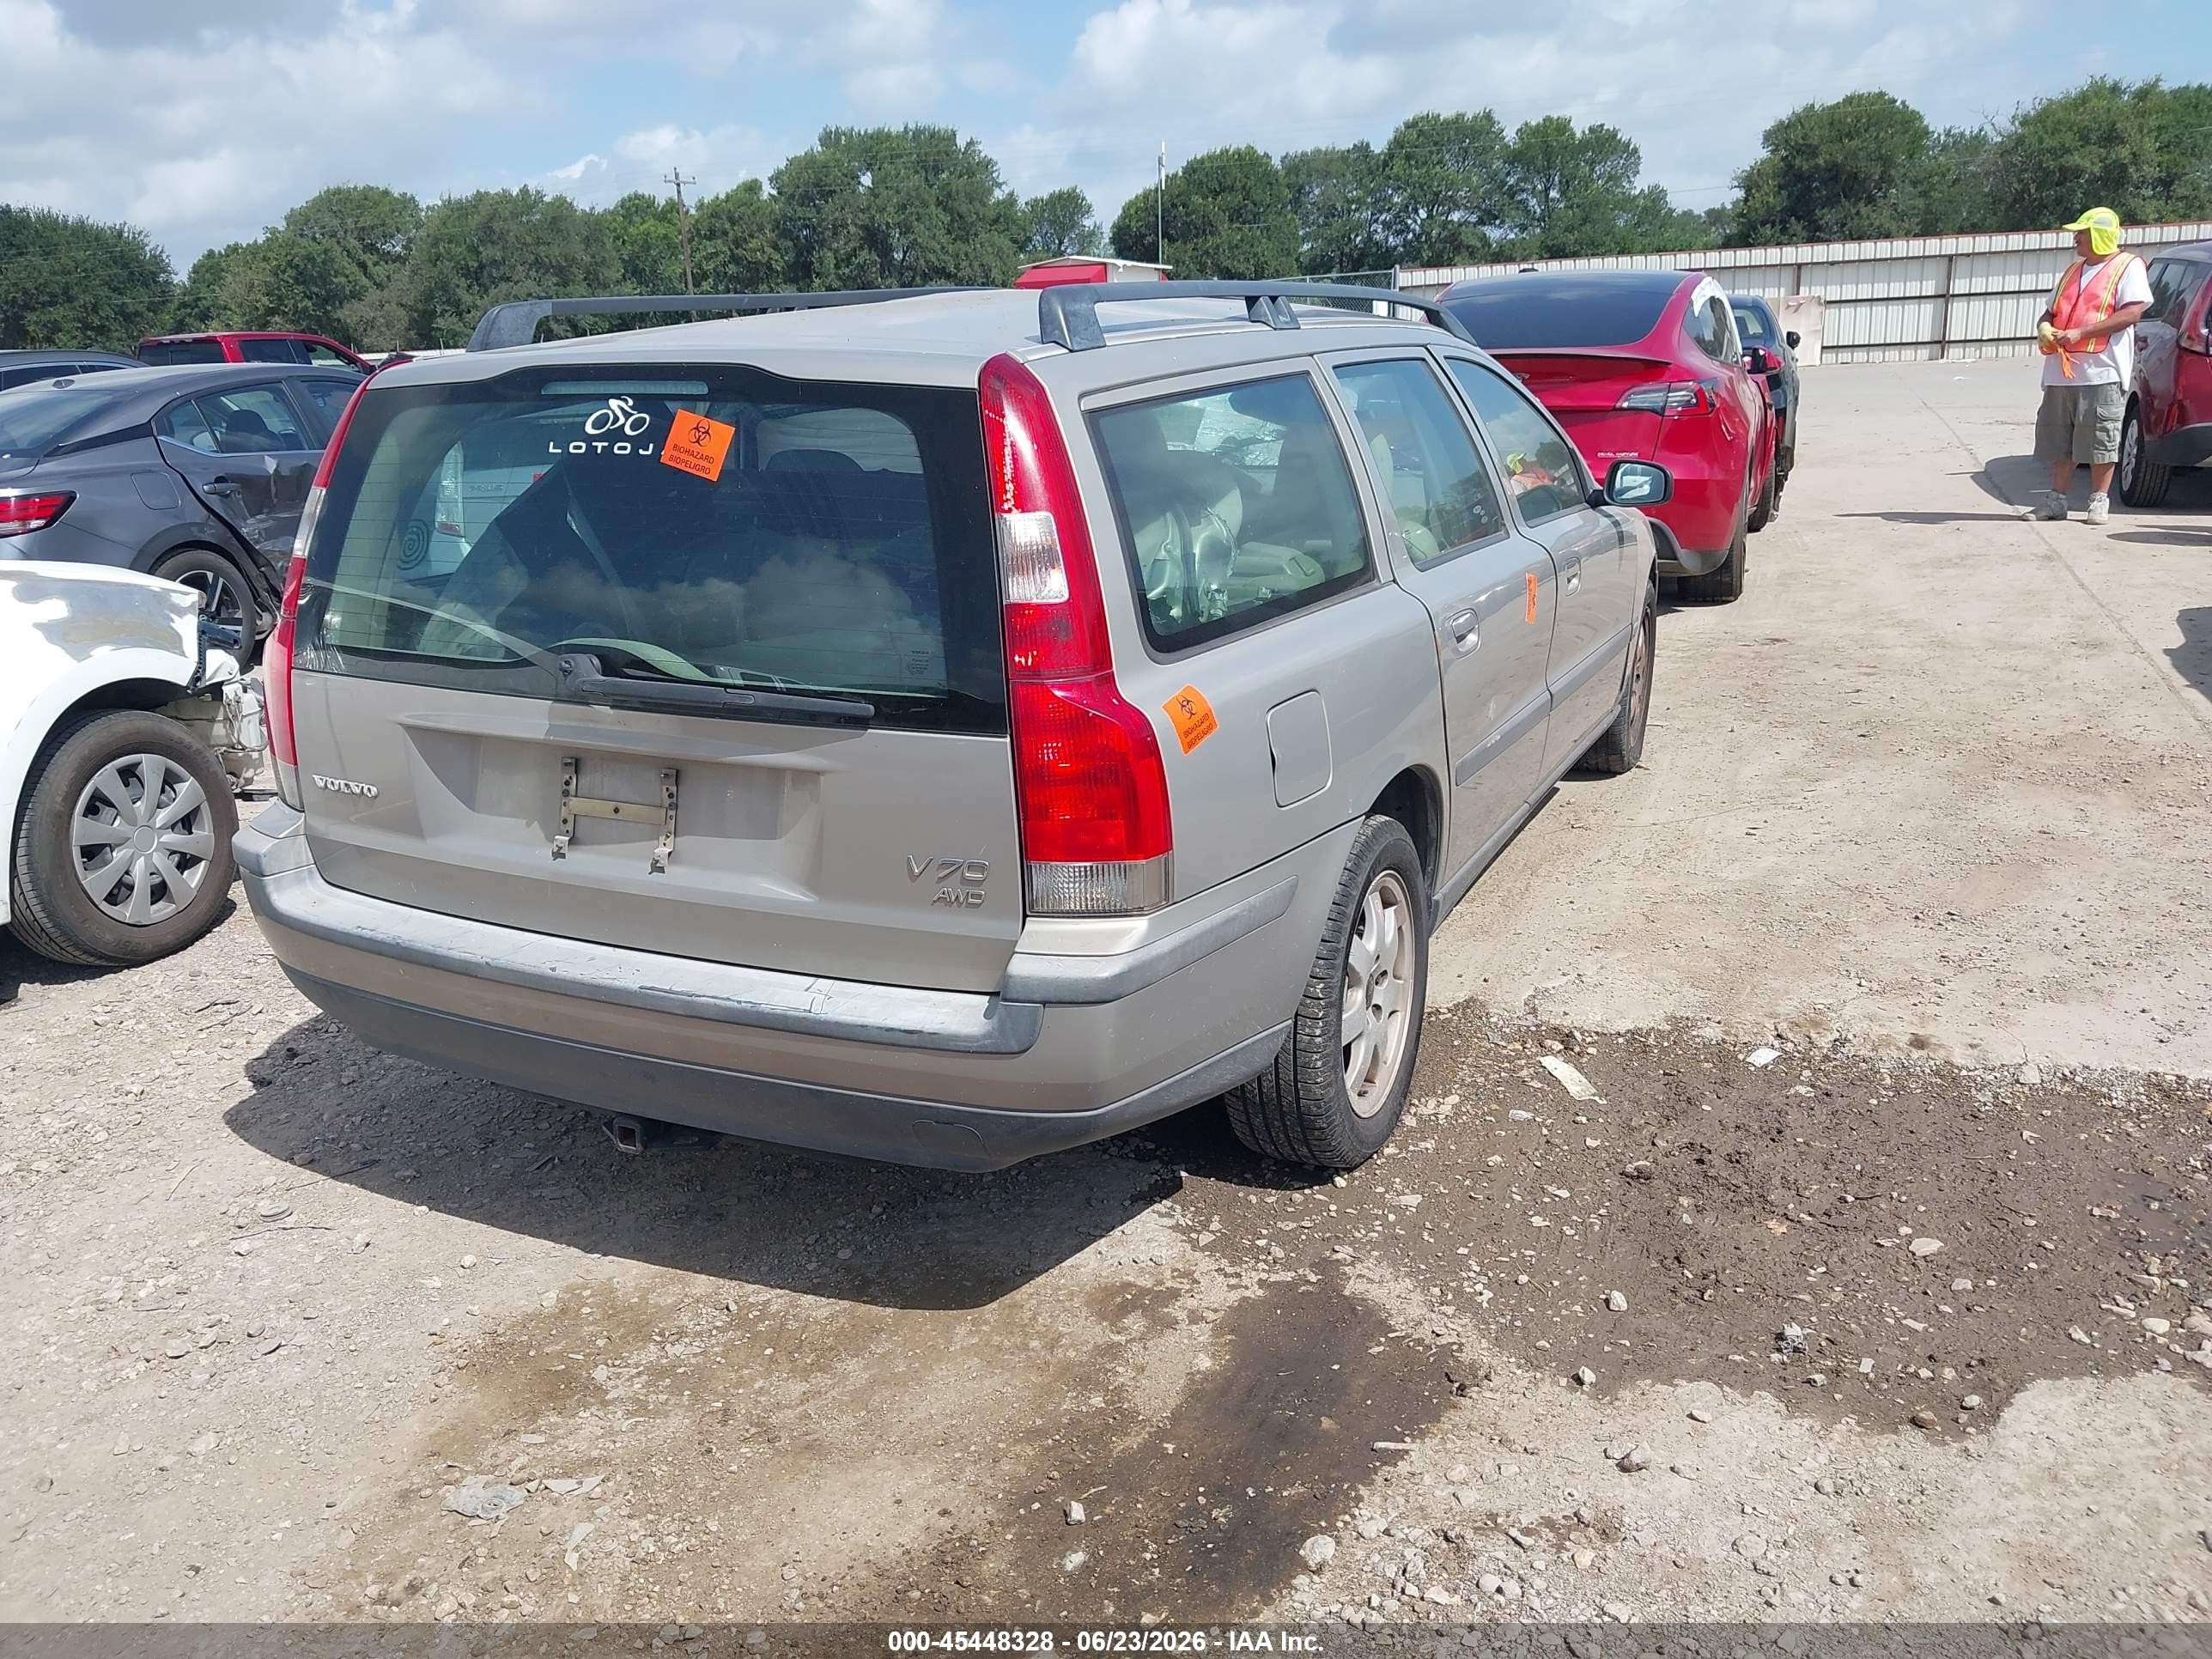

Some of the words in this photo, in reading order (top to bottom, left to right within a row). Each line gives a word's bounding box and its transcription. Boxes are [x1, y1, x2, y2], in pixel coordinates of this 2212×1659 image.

[548, 441, 665, 456] LOTOJ
[672, 442, 715, 465] BIOHAZARD
[667, 453, 711, 475] BIOPELIGRO
[1182, 713, 1210, 738] BIOHAZARD
[311, 774, 379, 798] VOLVO
[907, 854, 989, 881] V70
[932, 887, 985, 904] AWD
